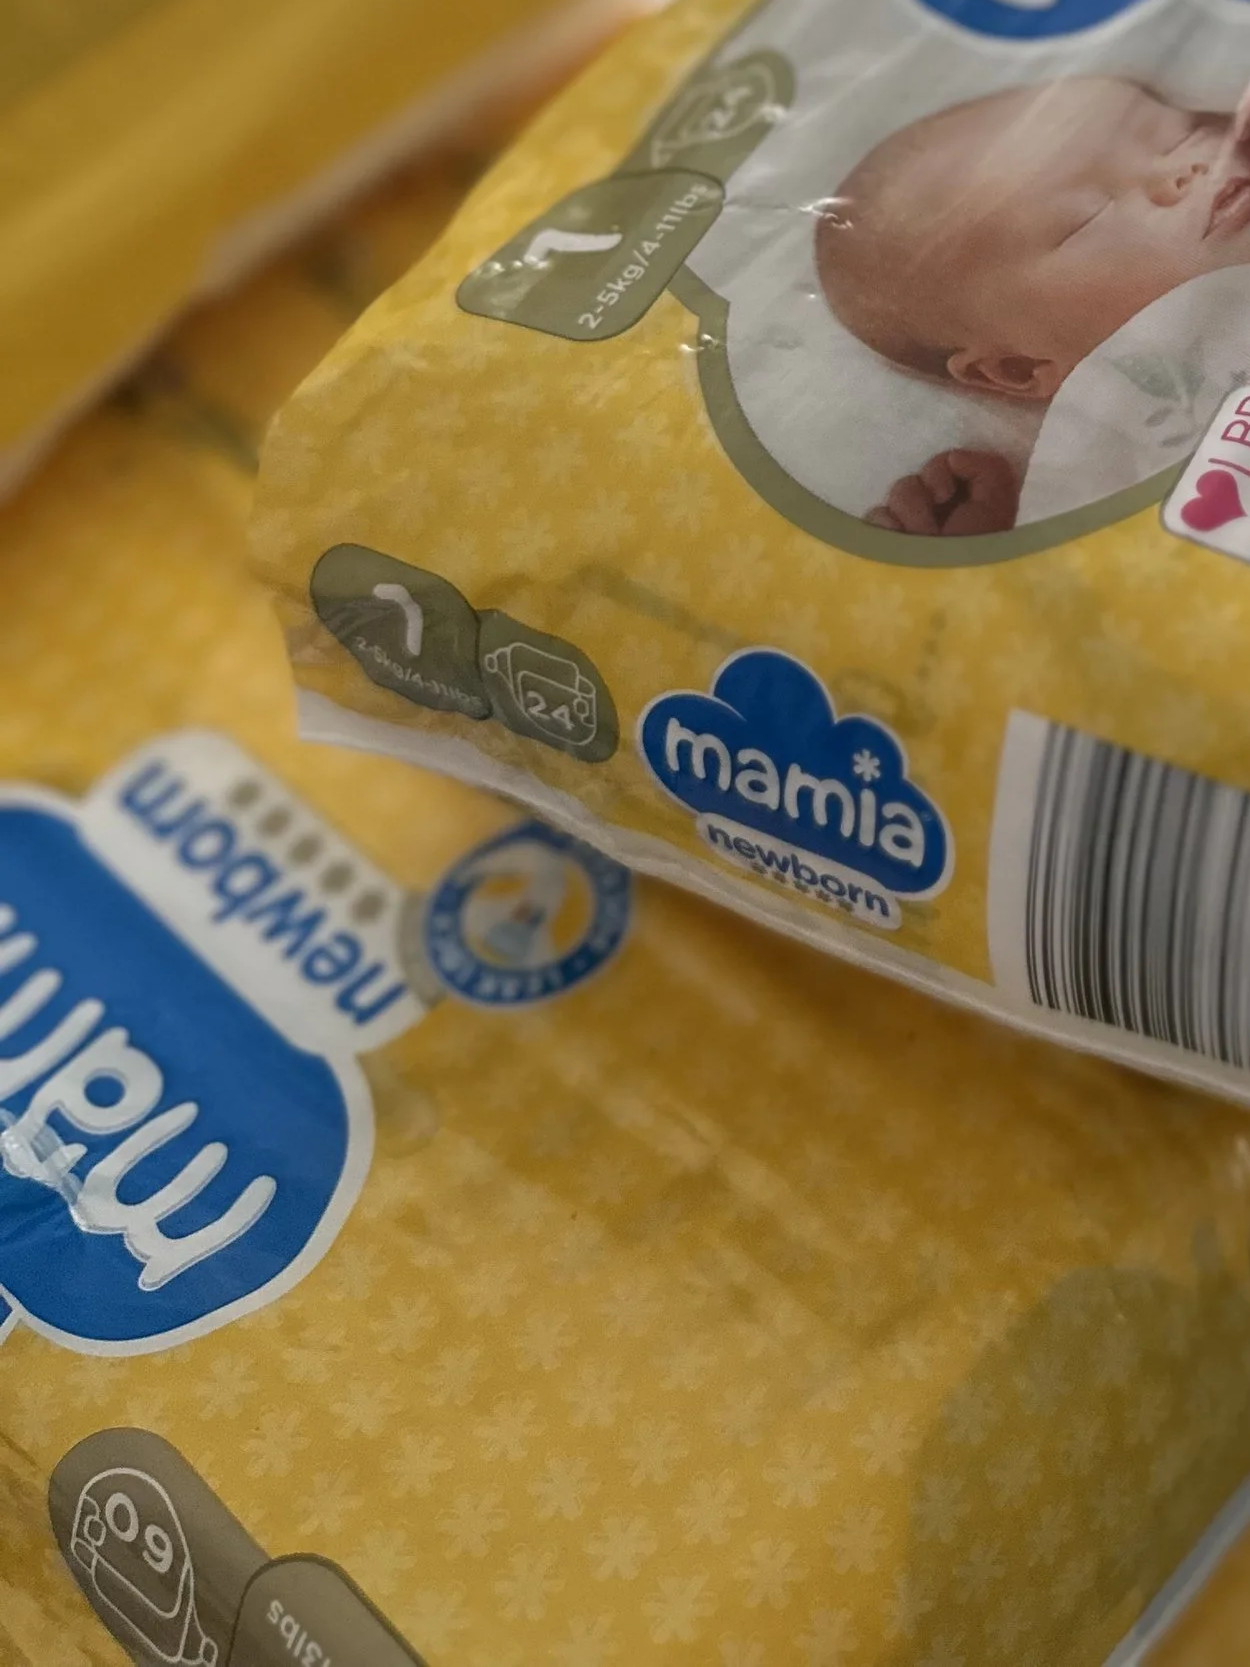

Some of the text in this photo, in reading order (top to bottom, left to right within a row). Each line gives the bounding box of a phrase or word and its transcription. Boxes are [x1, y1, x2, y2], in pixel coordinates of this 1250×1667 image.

[526, 689, 576, 732] 24
[664, 717, 926, 870] mamia
[116, 758, 408, 1028] newborn
[707, 823, 890, 917] newborn
[0, 902, 277, 1291] mam
[105, 1492, 174, 1574] 60
